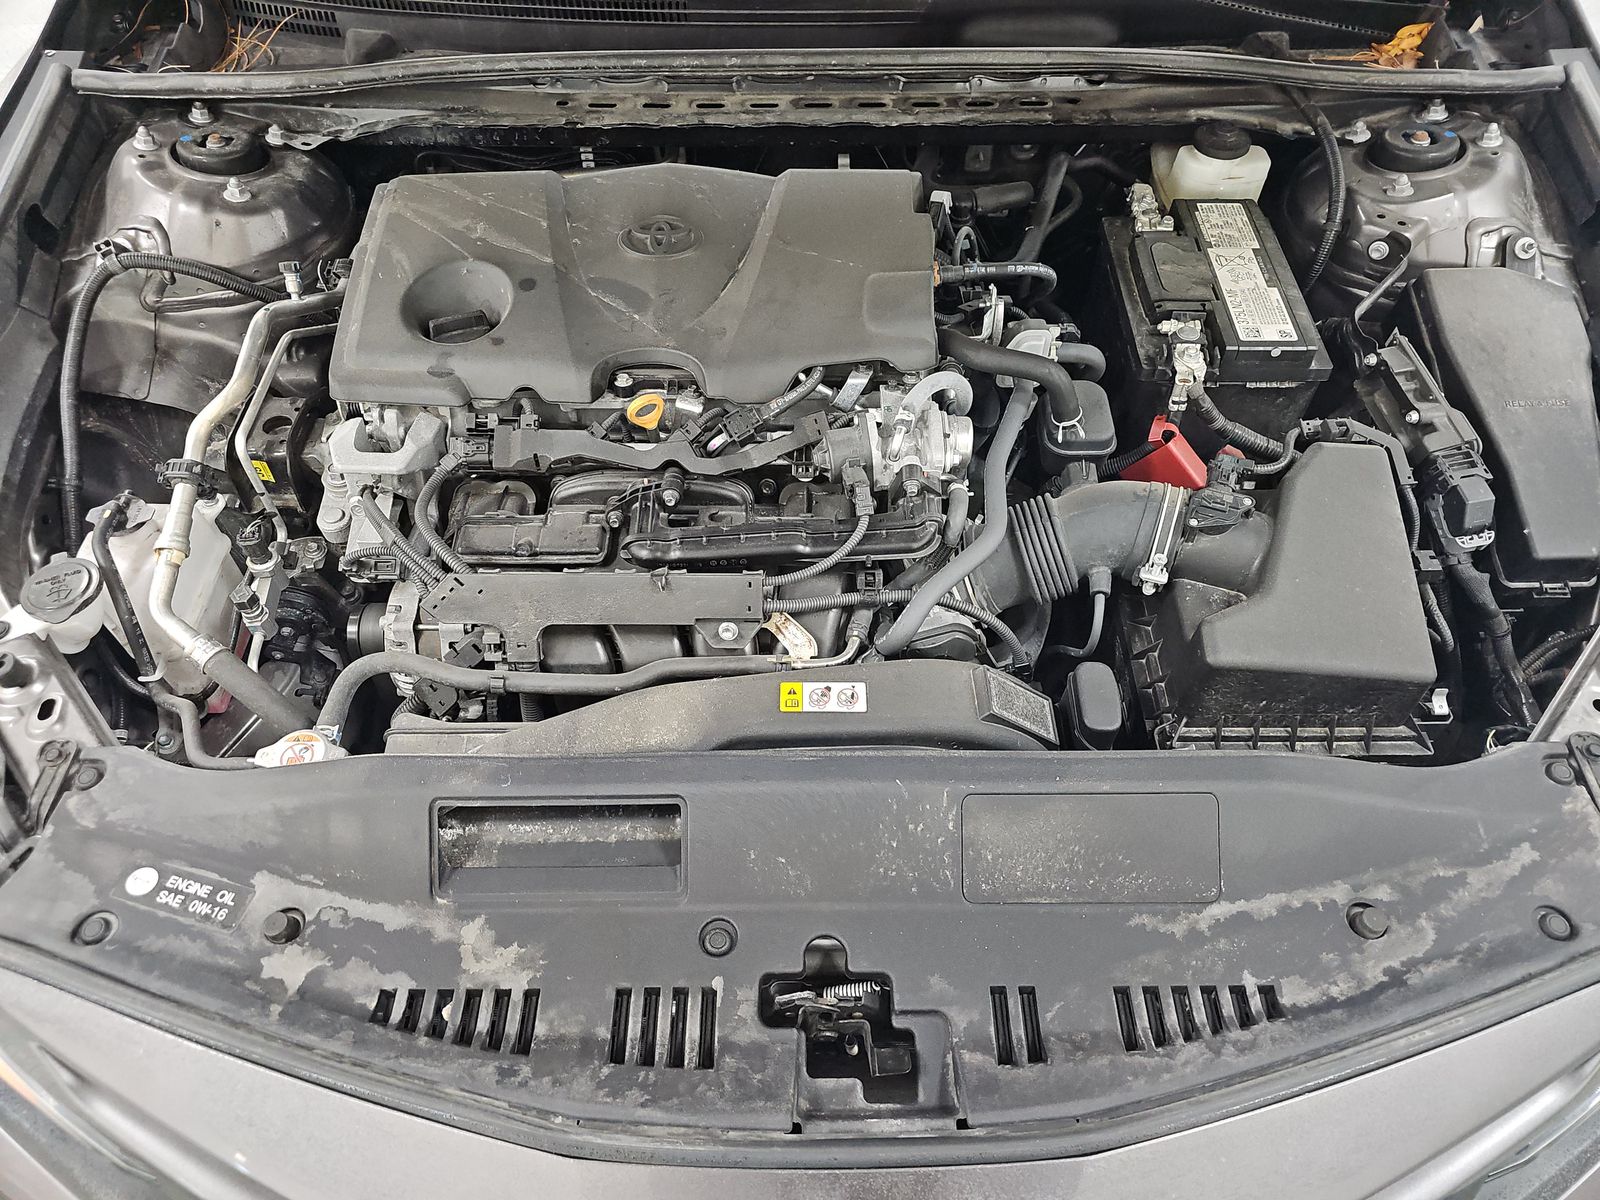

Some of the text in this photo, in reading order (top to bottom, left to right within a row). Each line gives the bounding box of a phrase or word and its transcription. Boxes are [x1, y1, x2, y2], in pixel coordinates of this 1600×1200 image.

[1225, 288, 1250, 324] 375LN2-MF
[1504, 400, 1534, 408] RELAY
[64, 569, 82, 577] FLUID
[156, 890, 228, 920] SAE 0W-16
[165, 875, 235, 906] ENGINE OIL
